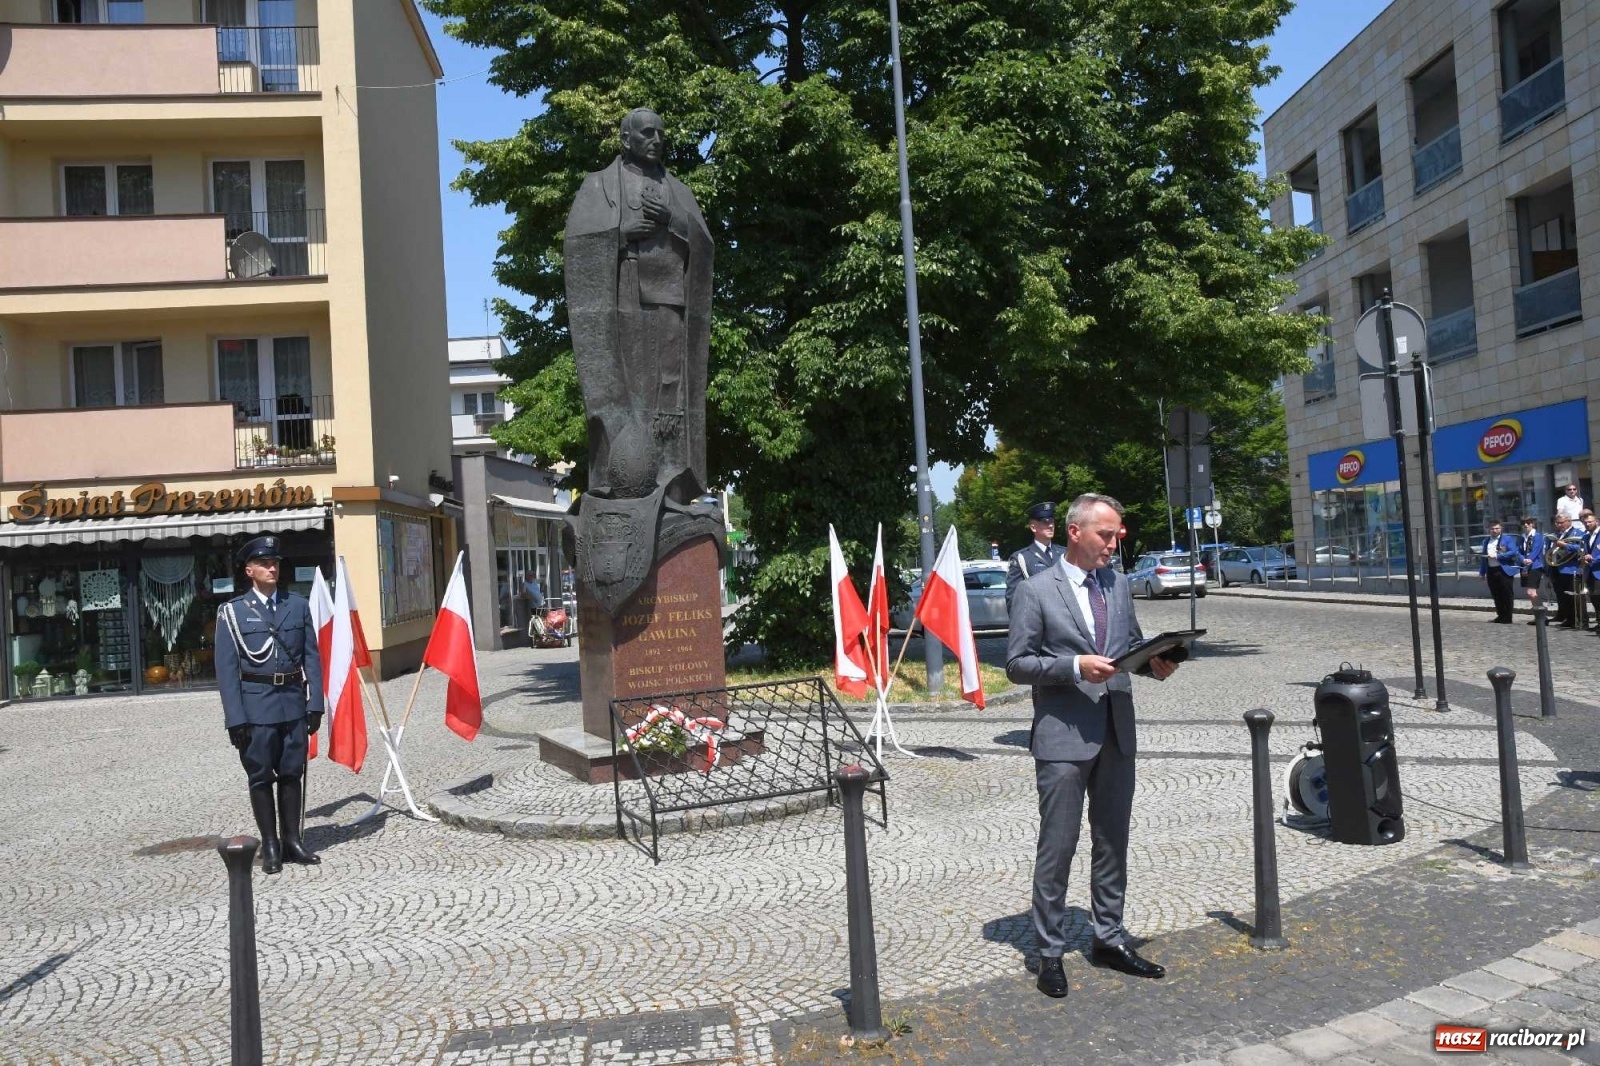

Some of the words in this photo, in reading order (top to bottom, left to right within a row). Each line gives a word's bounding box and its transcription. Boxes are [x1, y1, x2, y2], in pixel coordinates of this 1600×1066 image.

[1483, 432, 1513, 449] PEPCO
[1339, 461, 1358, 473] PEPCO
[9, 482, 123, 520] Świat
[130, 478, 314, 514] Prezentów
[668, 608, 713, 623] FELIKS
[639, 626, 697, 642] GAWLINA
[629, 665, 664, 676] BISKUP
[668, 659, 710, 672] POLOWY
[628, 678, 661, 690] WOJSK
[665, 672, 712, 686] POLSKICH
